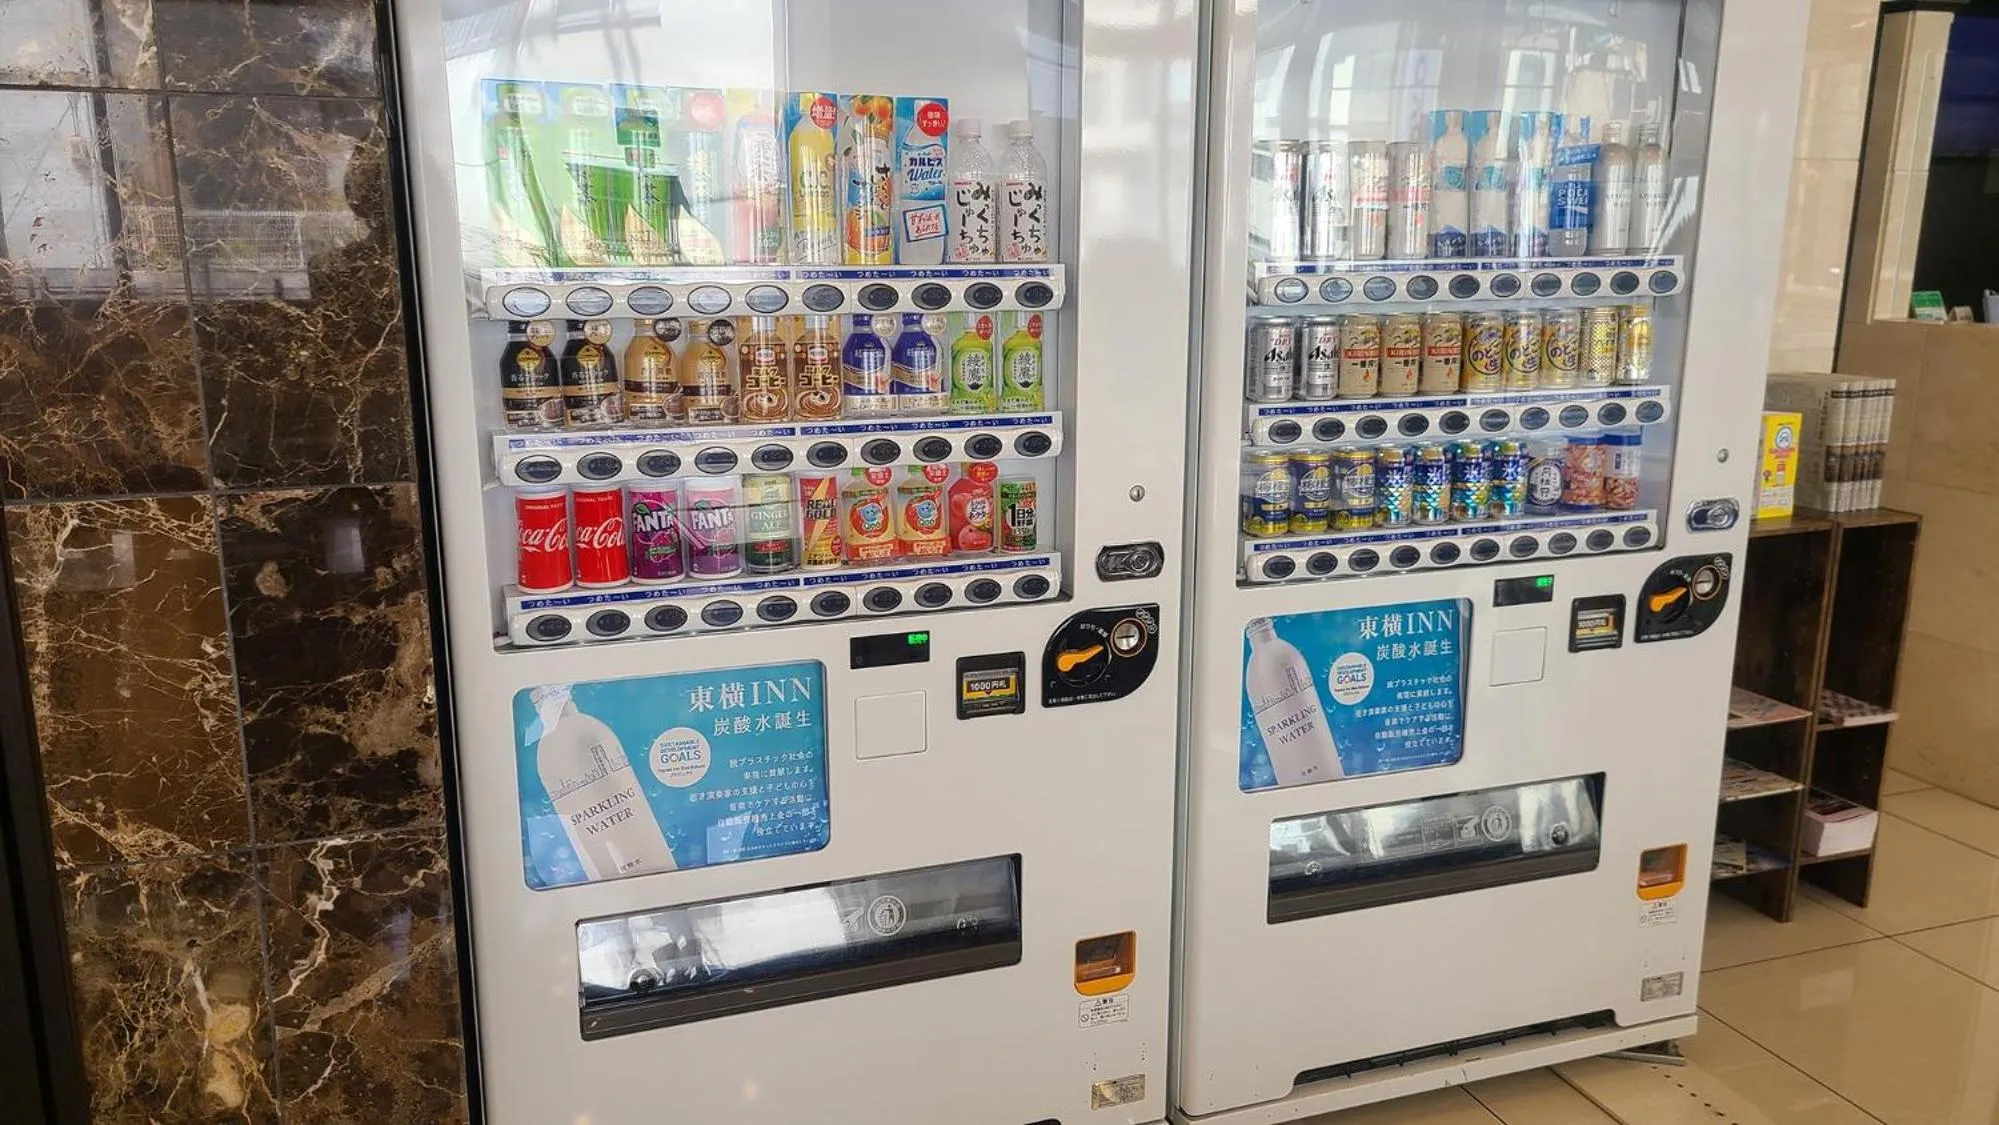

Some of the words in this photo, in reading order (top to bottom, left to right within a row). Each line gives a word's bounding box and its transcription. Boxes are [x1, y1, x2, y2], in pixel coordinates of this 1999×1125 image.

[908, 157, 943, 167] カルピス
[906, 168, 944, 181] Water
[691, 507, 734, 530] FANTA
[1358, 609, 1453, 640] 東横INN
[1376, 638, 1453, 661] 炭酸水誕生
[1337, 672, 1367, 684] GOALS
[688, 676, 812, 713] 東横INN
[713, 709, 812, 737] 炭酸水誕生
[1267, 703, 1318, 737] SPARKLING
[1278, 722, 1314, 746] WATER
[660, 751, 702, 764] GOALS
[570, 786, 636, 826] SPARKLING
[585, 806, 635, 837] WATER
